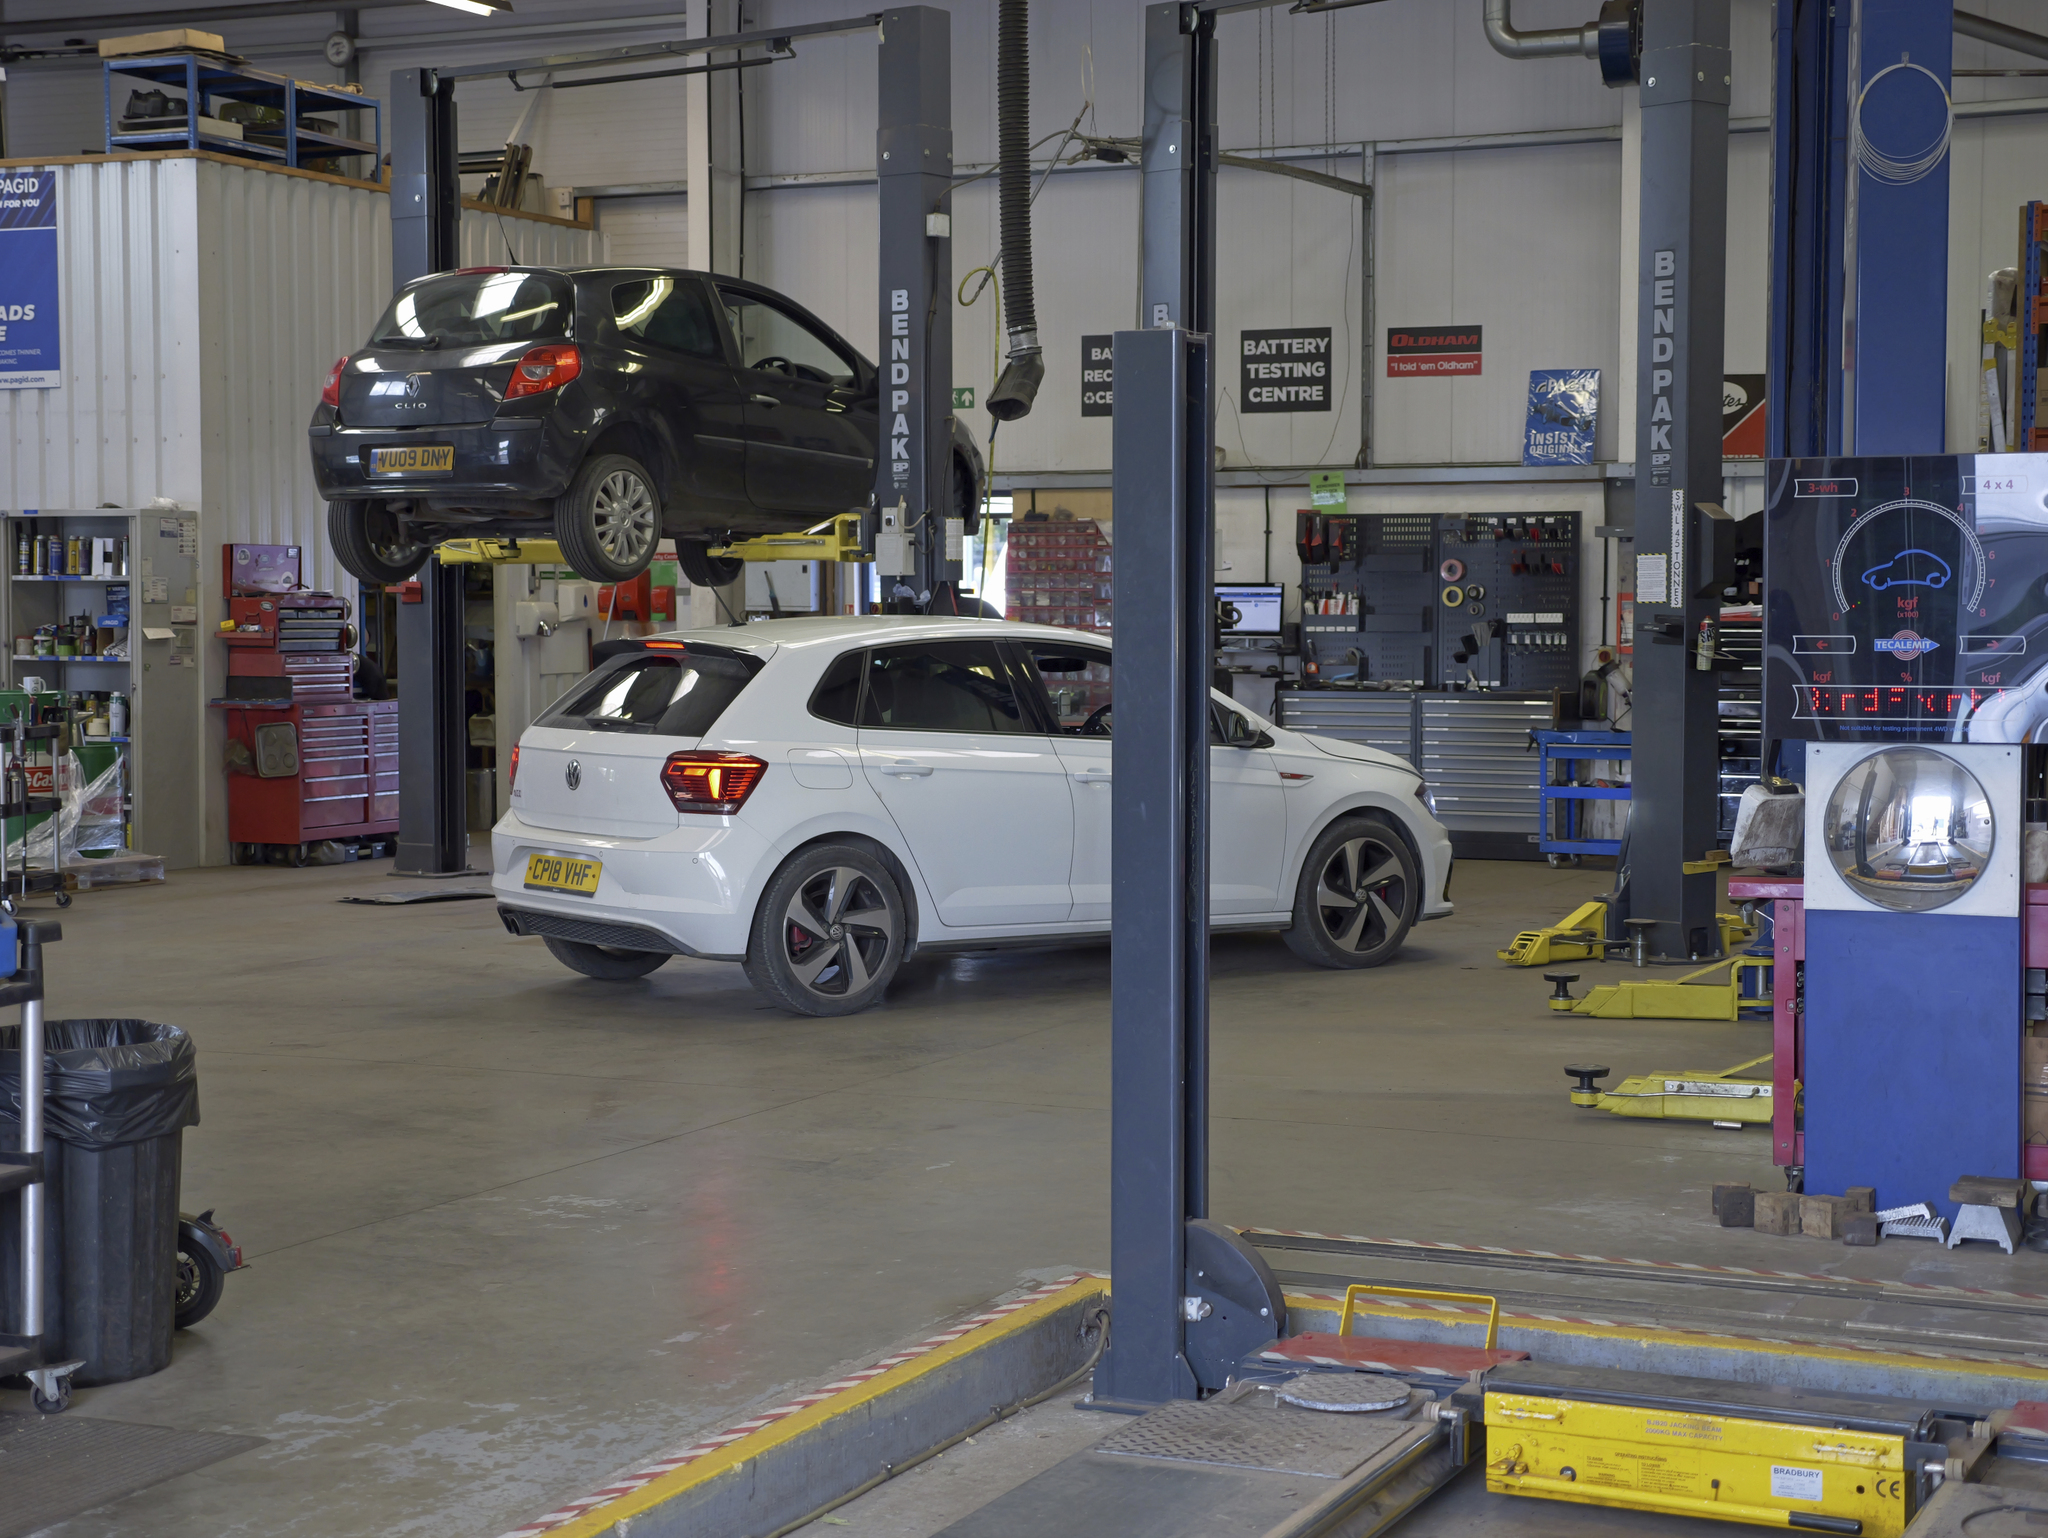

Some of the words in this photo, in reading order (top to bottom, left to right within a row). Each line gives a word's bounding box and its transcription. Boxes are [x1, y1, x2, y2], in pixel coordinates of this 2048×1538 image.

[4, 200, 21, 208] FOR
[22, 198, 40, 207] YOU
[1153, 304, 1169, 327] B
[1391, 334, 1479, 347] OLDHAM
[1244, 338, 1330, 355] BATTERY
[1651, 251, 1675, 450] BENDPAK
[1091, 347, 1113, 360] BA
[892, 290, 909, 459] BENDPAK
[1246, 361, 1326, 378] TESTING
[1248, 386, 1324, 402] CENTRE
[1530, 432, 1577, 445] INSIST
[1529, 445, 1587, 454] ORIGINALS
[380, 450, 417, 468] VU09
[420, 448, 451, 467] DNY
[1652, 454, 1670, 465] BP
[893, 462, 909, 472] BP
[1808, 482, 1838, 493] 3-wh
[1983, 480, 1991, 490] 4
[2005, 480, 2013, 489] 4
[1903, 487, 1910, 496] 3
[1850, 509, 1857, 517] 2
[1956, 503, 1963, 512] 4
[1988, 551, 1995, 560] 6
[1825, 559, 1830, 567] 1
[1673, 552, 1681, 606] TONNES
[1989, 579, 1996, 588] 7
[1897, 597, 1918, 611] kgf
[1832, 612, 1840, 621] 0
[1897, 611, 1919, 619] (x100)
[1979, 608, 1987, 618] 8
[1876, 641, 1932, 650] TECALEMIT
[1813, 671, 1832, 684] kgf
[1901, 672, 1913, 682] %
[1981, 672, 2001, 685] kgf
[532, 859, 562, 882] CP18
[565, 862, 592, 886] VHF
[1670, 1422, 1699, 1430] JACKING
[1702, 1425, 1722, 1433] BEAM
[1689, 1433, 1723, 1441] CAPACITY
[1773, 1467, 1820, 1478] BRADBURY
